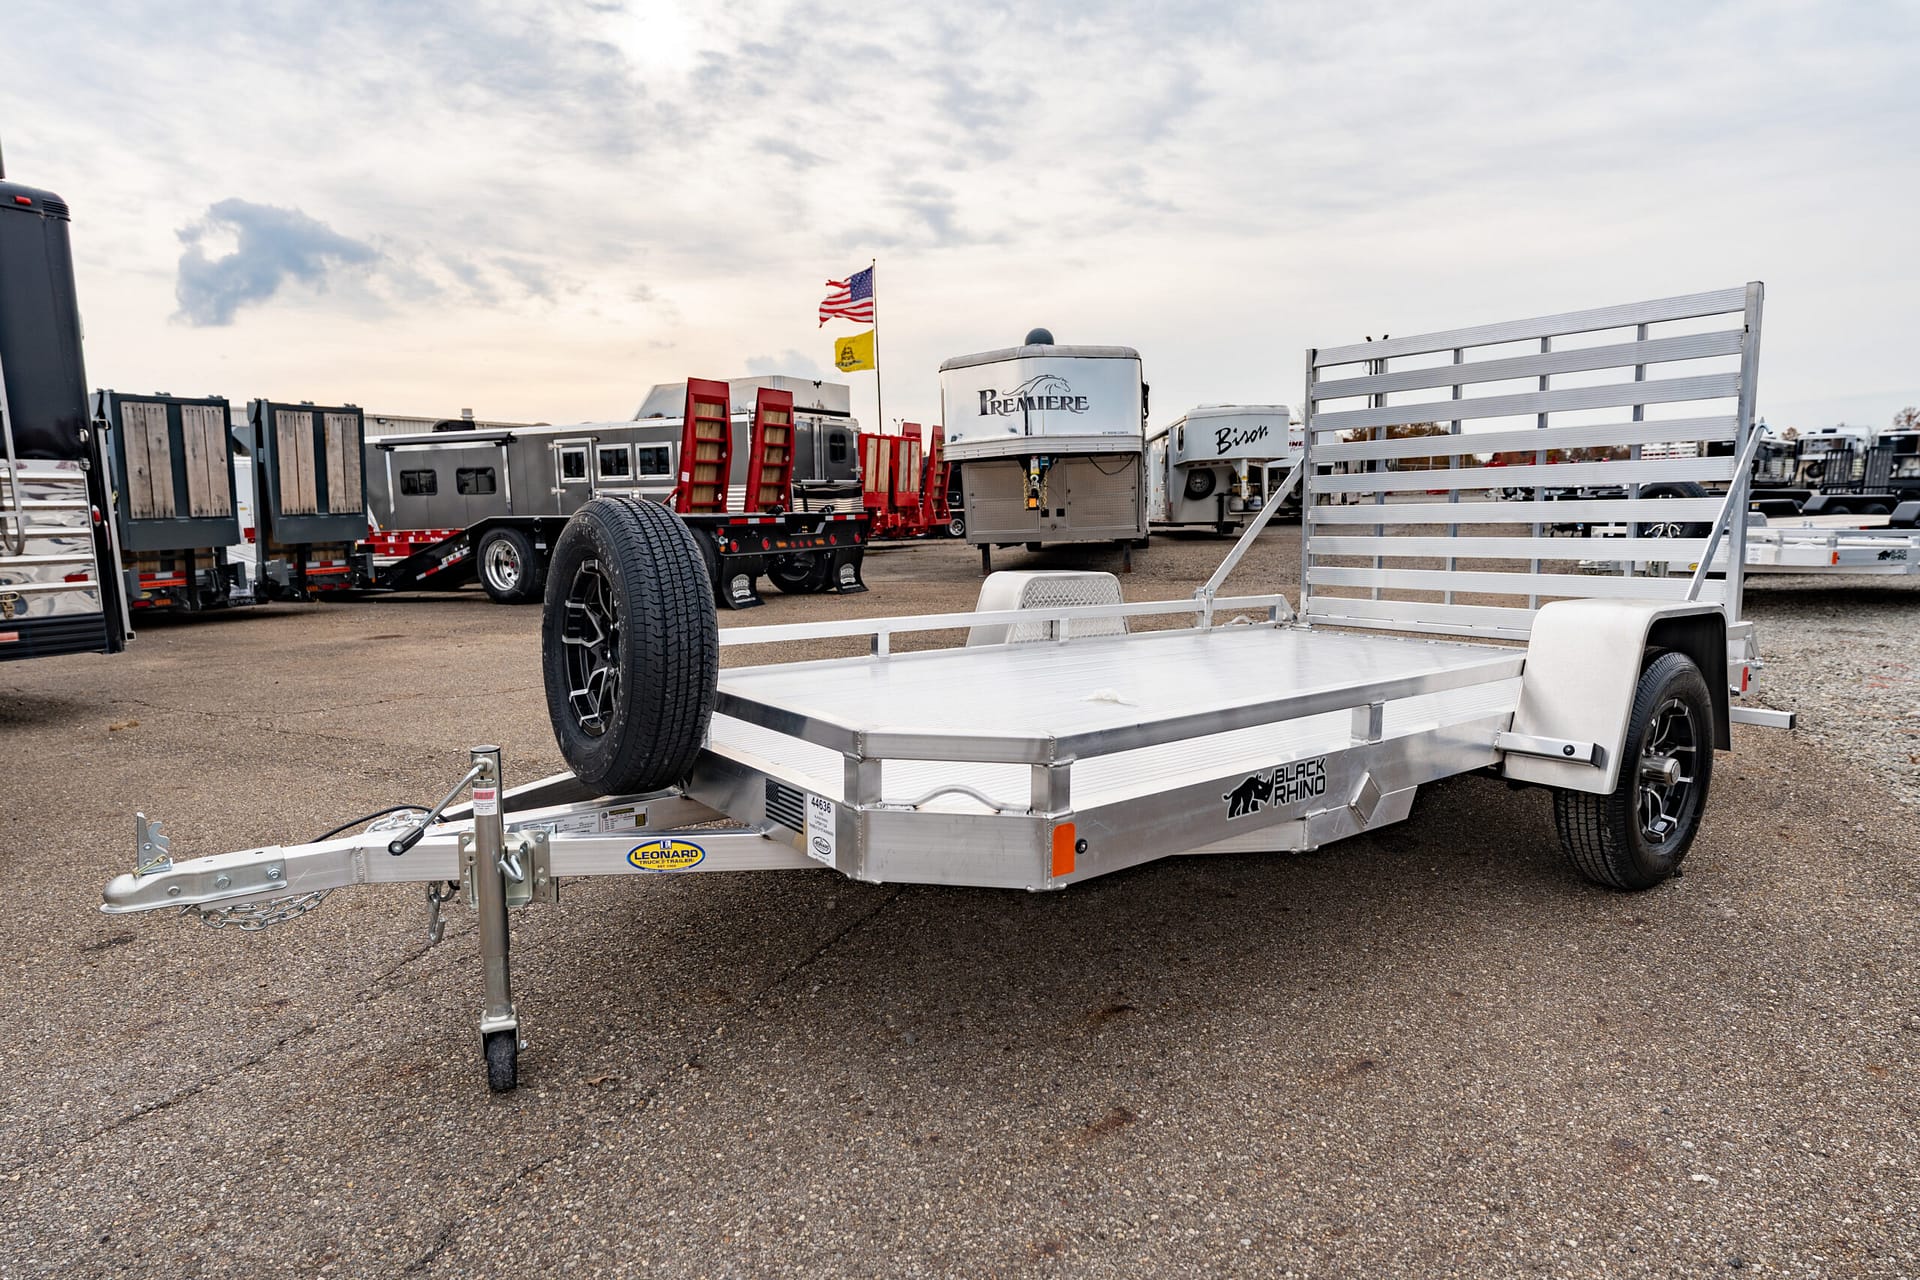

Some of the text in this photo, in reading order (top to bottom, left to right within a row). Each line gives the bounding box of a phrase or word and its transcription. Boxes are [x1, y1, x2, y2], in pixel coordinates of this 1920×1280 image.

[977, 389, 1090, 416] PREMIERE
[1215, 425, 1269, 455] Bison
[1274, 758, 1326, 785] BLACK
[1274, 774, 1326, 807] RHINO
[811, 797, 832, 814] 44636
[634, 849, 699, 860] LEONARD
